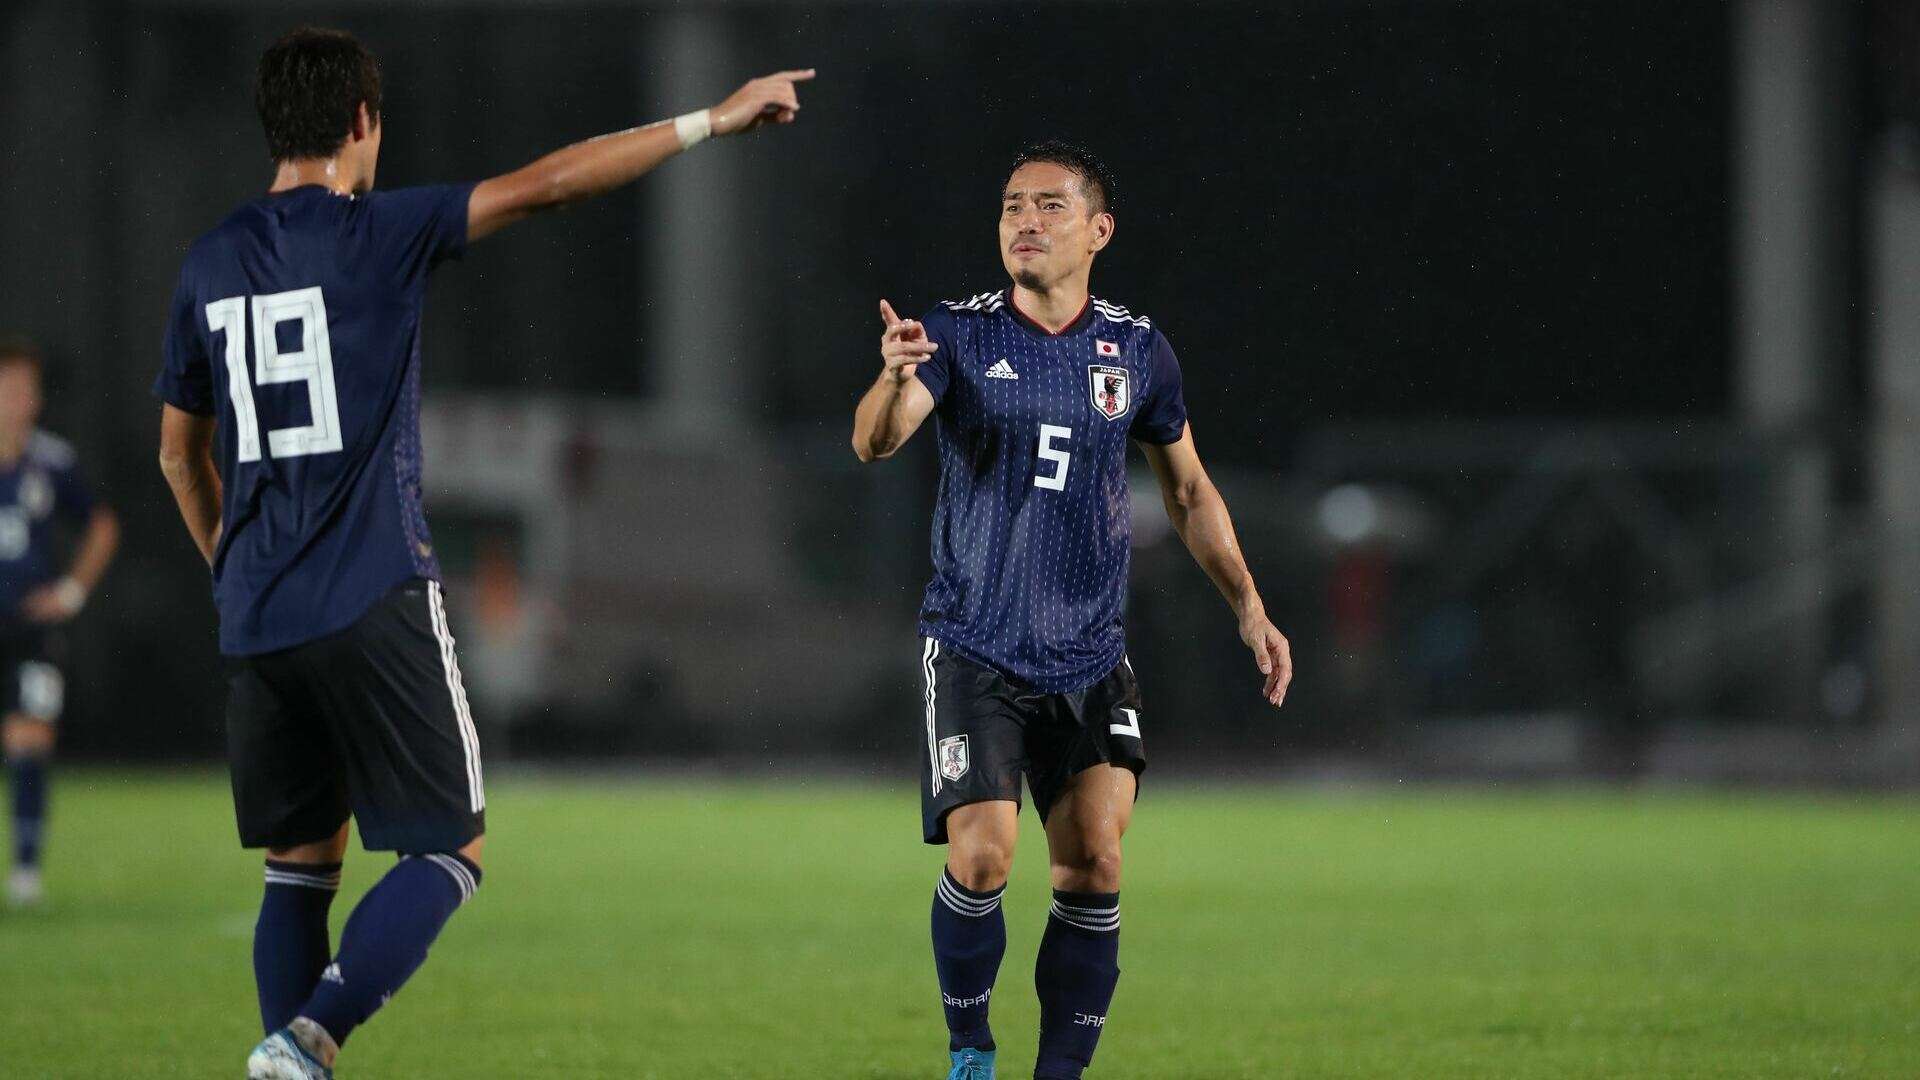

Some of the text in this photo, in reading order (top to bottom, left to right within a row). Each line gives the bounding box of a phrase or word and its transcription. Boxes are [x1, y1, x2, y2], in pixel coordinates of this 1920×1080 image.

[205, 285, 343, 462] 19
[985, 370, 1018, 380] adidas
[1100, 367, 1120, 375] JAPAN
[1034, 423, 1072, 491] 5
